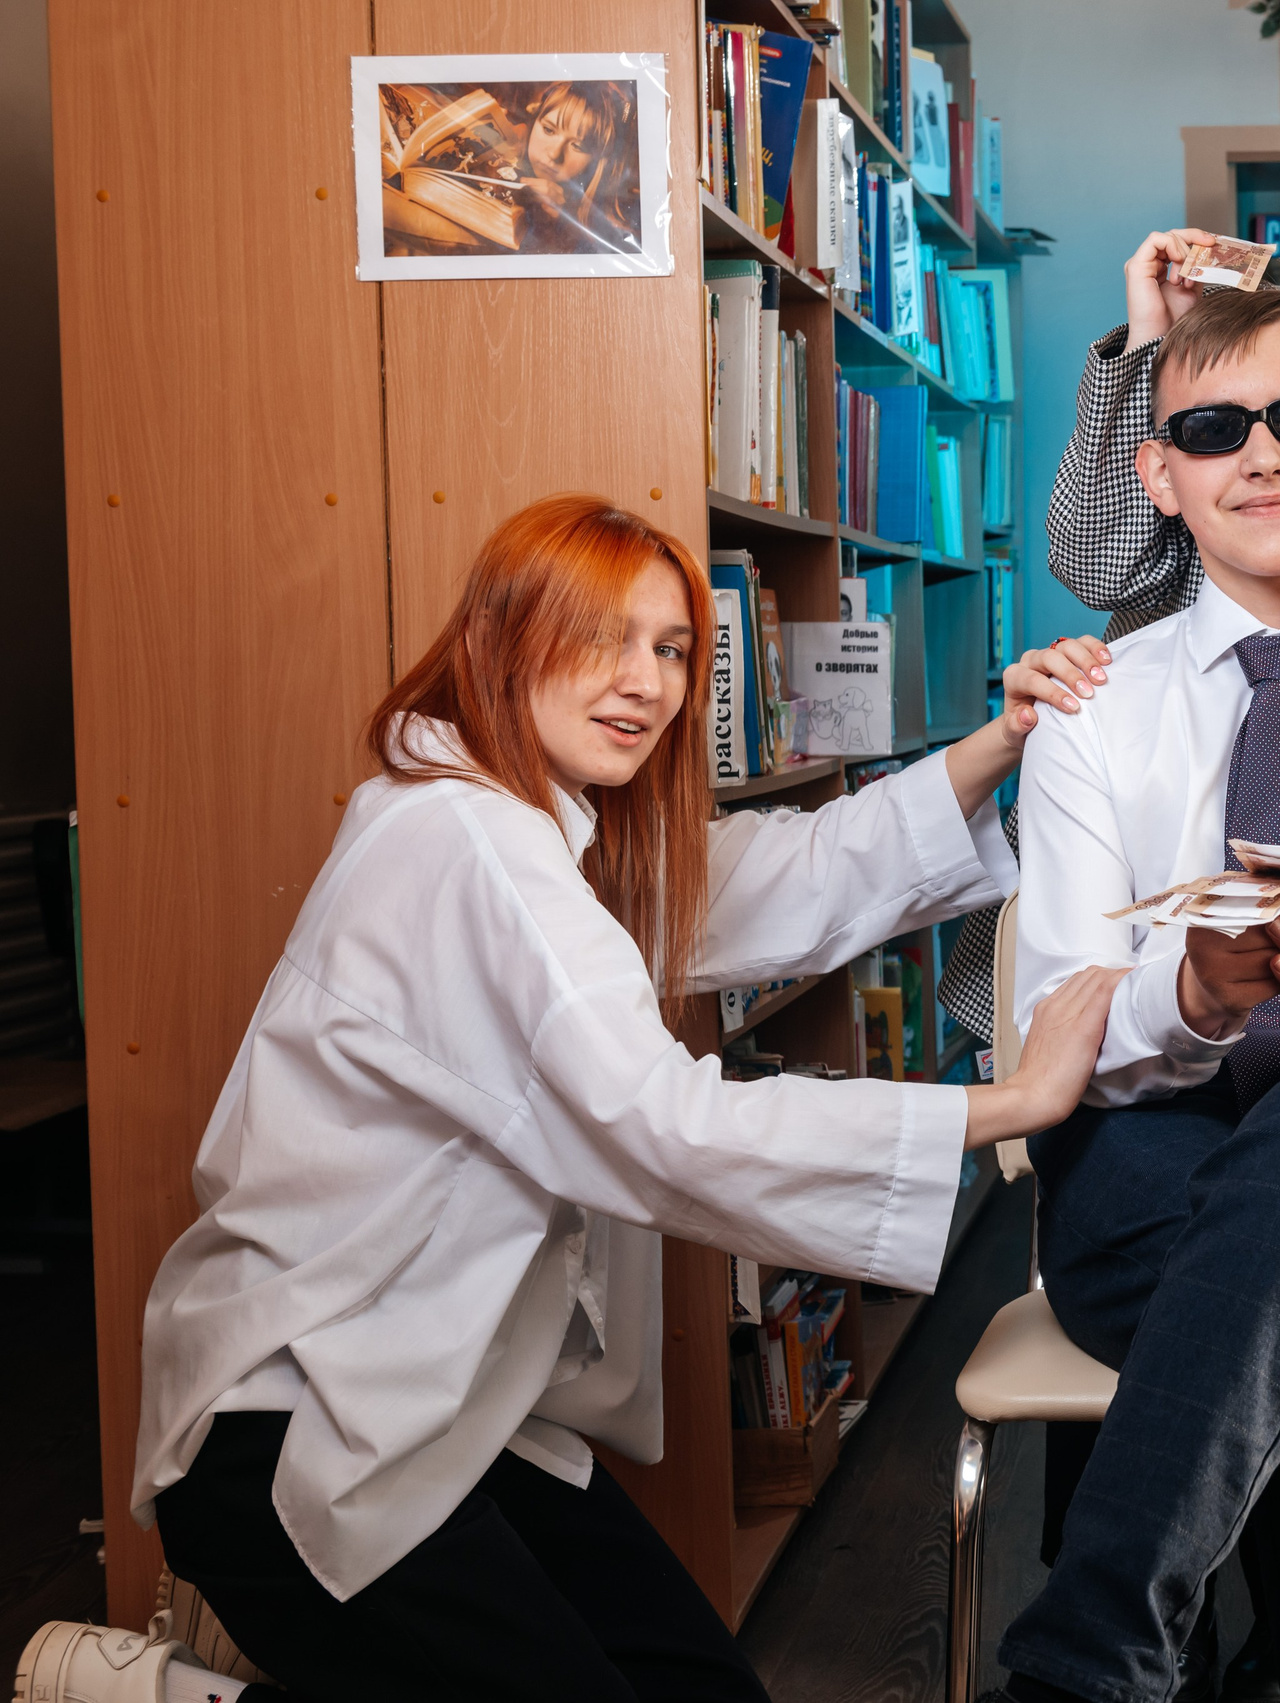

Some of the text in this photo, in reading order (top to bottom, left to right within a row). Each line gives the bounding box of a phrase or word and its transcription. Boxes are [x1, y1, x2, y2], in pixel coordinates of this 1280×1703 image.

[842, 628, 879, 640] Добрые
[841, 644, 879, 654] истории
[815, 661, 879, 675] о зверятах
[714, 622, 740, 780] рассказы
